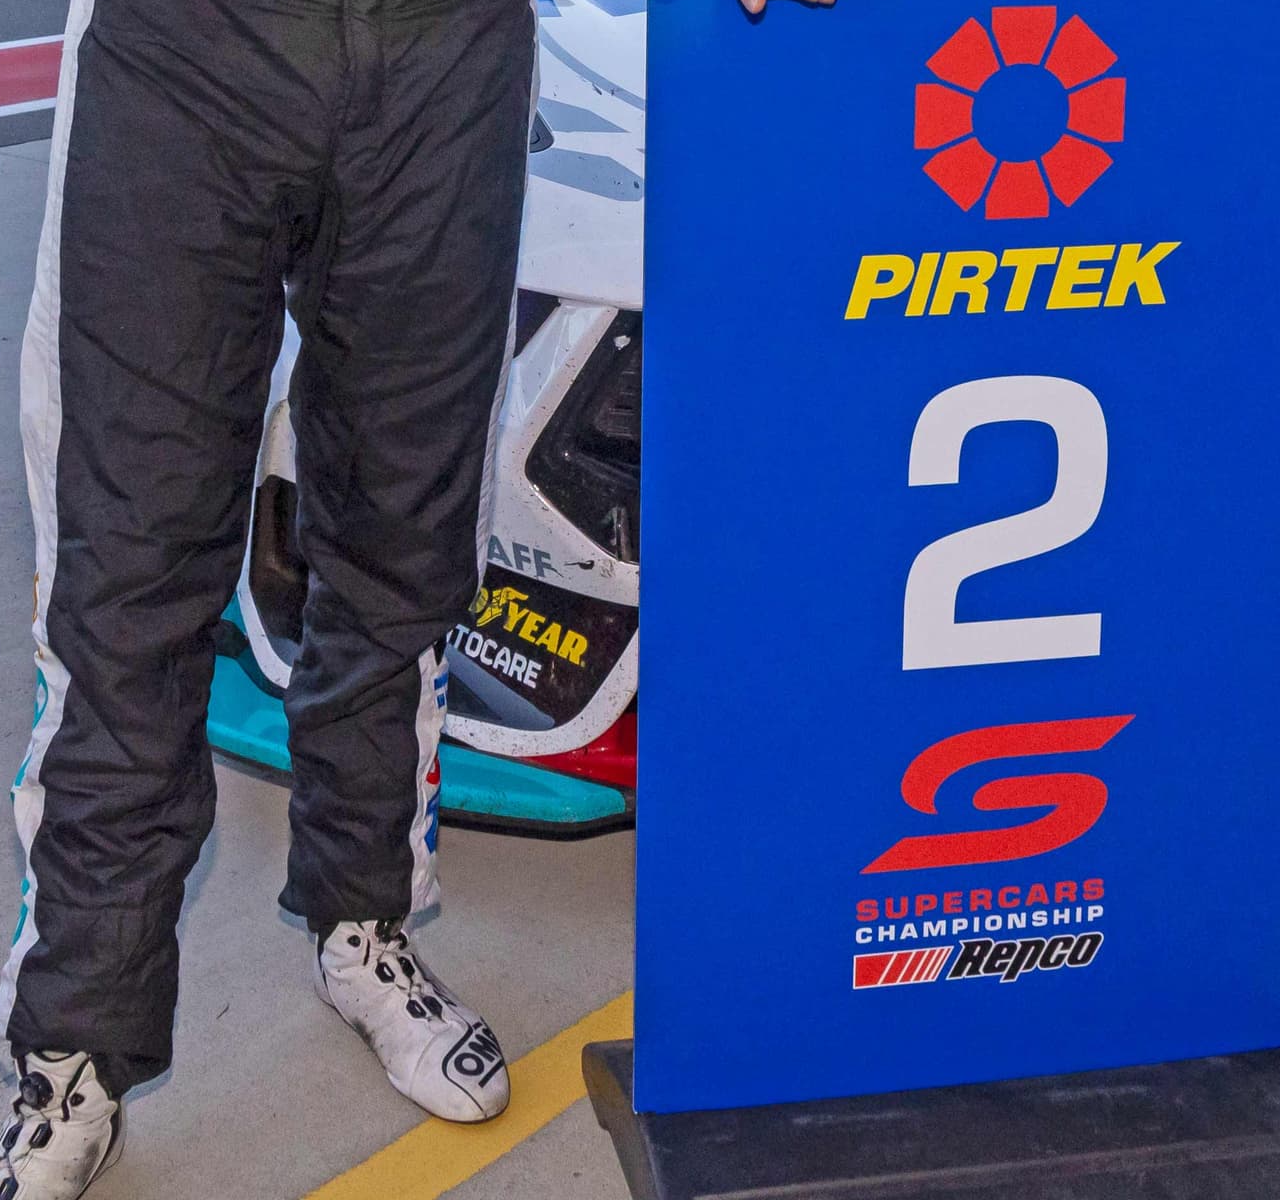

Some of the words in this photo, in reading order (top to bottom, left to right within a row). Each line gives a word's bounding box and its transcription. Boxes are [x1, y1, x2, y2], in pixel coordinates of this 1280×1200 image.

[844, 241, 1182, 321] PIRTEK
[903, 374, 1110, 672] 2
[488, 536, 552, 578] AFF
[447, 623, 542, 689] TOCARE
[855, 905, 1105, 944] CHAMPIONSHIP
[856, 878, 1105, 923] SUPERCARS
[946, 931, 1105, 984] Repco
